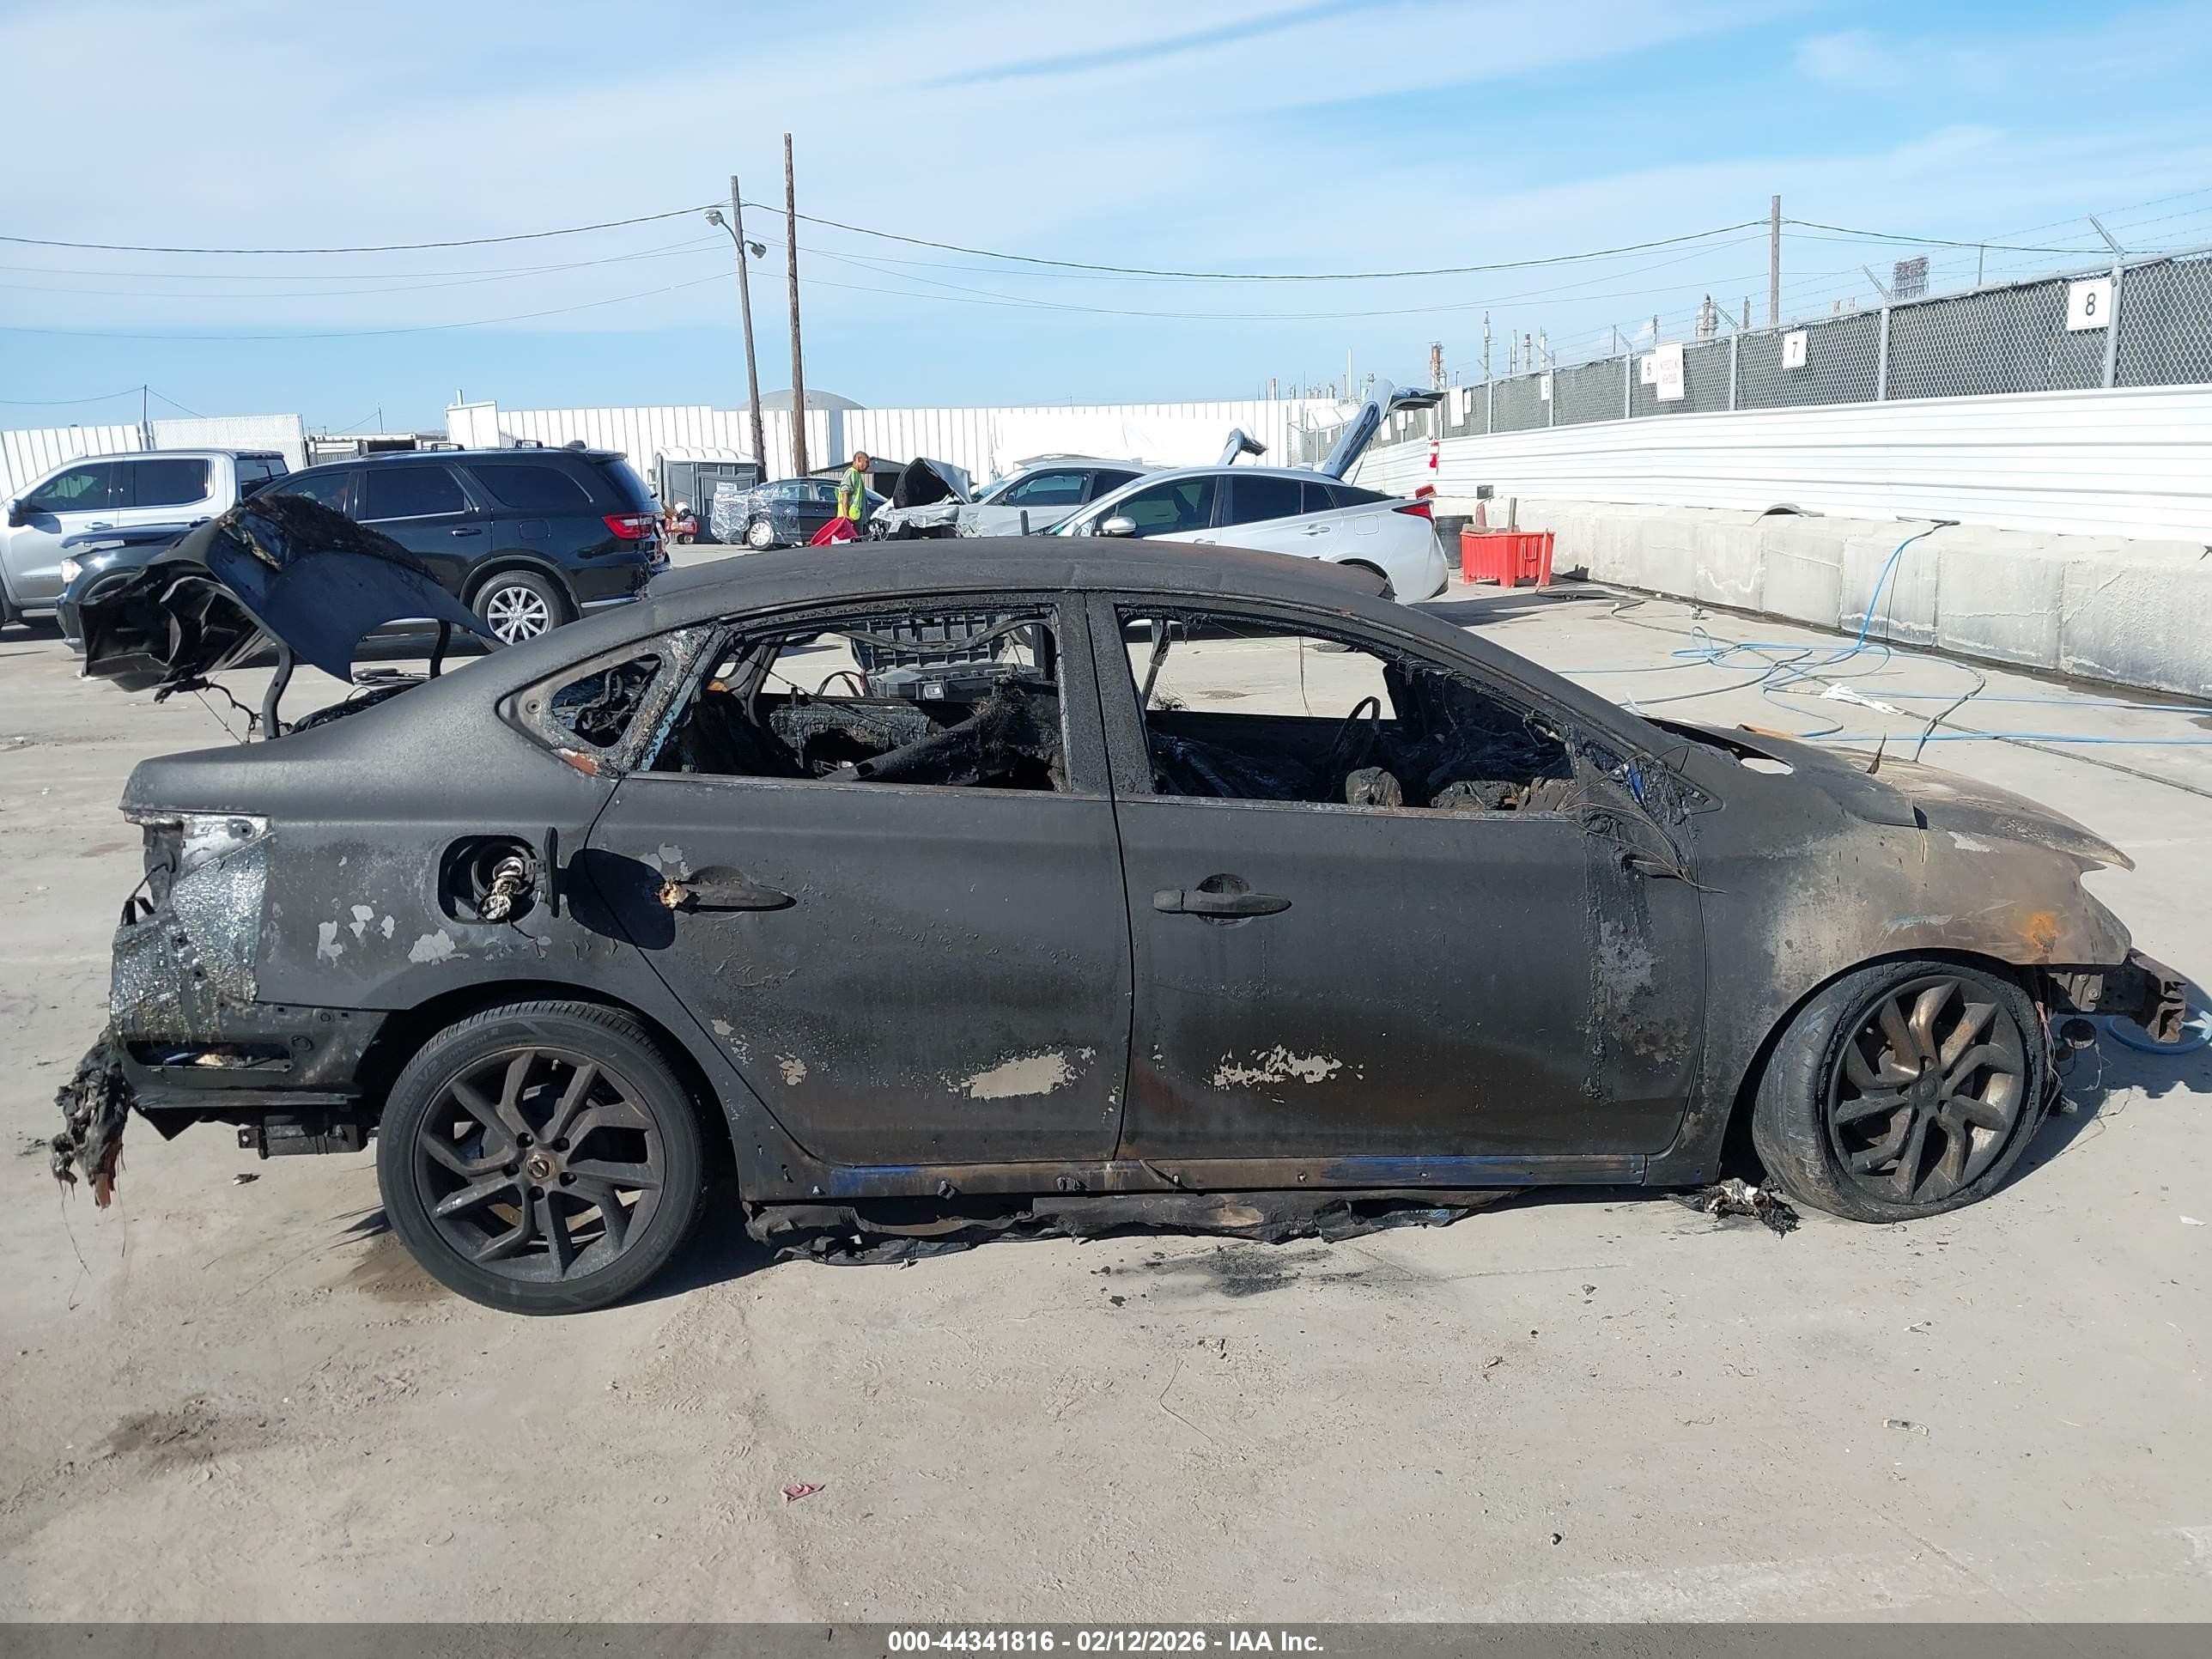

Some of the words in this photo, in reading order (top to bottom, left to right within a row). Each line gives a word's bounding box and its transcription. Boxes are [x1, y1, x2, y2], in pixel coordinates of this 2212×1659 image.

[2085, 292, 2096, 316] 8
[1791, 341, 1799, 358] 7
[1647, 362, 1652, 376] 6
